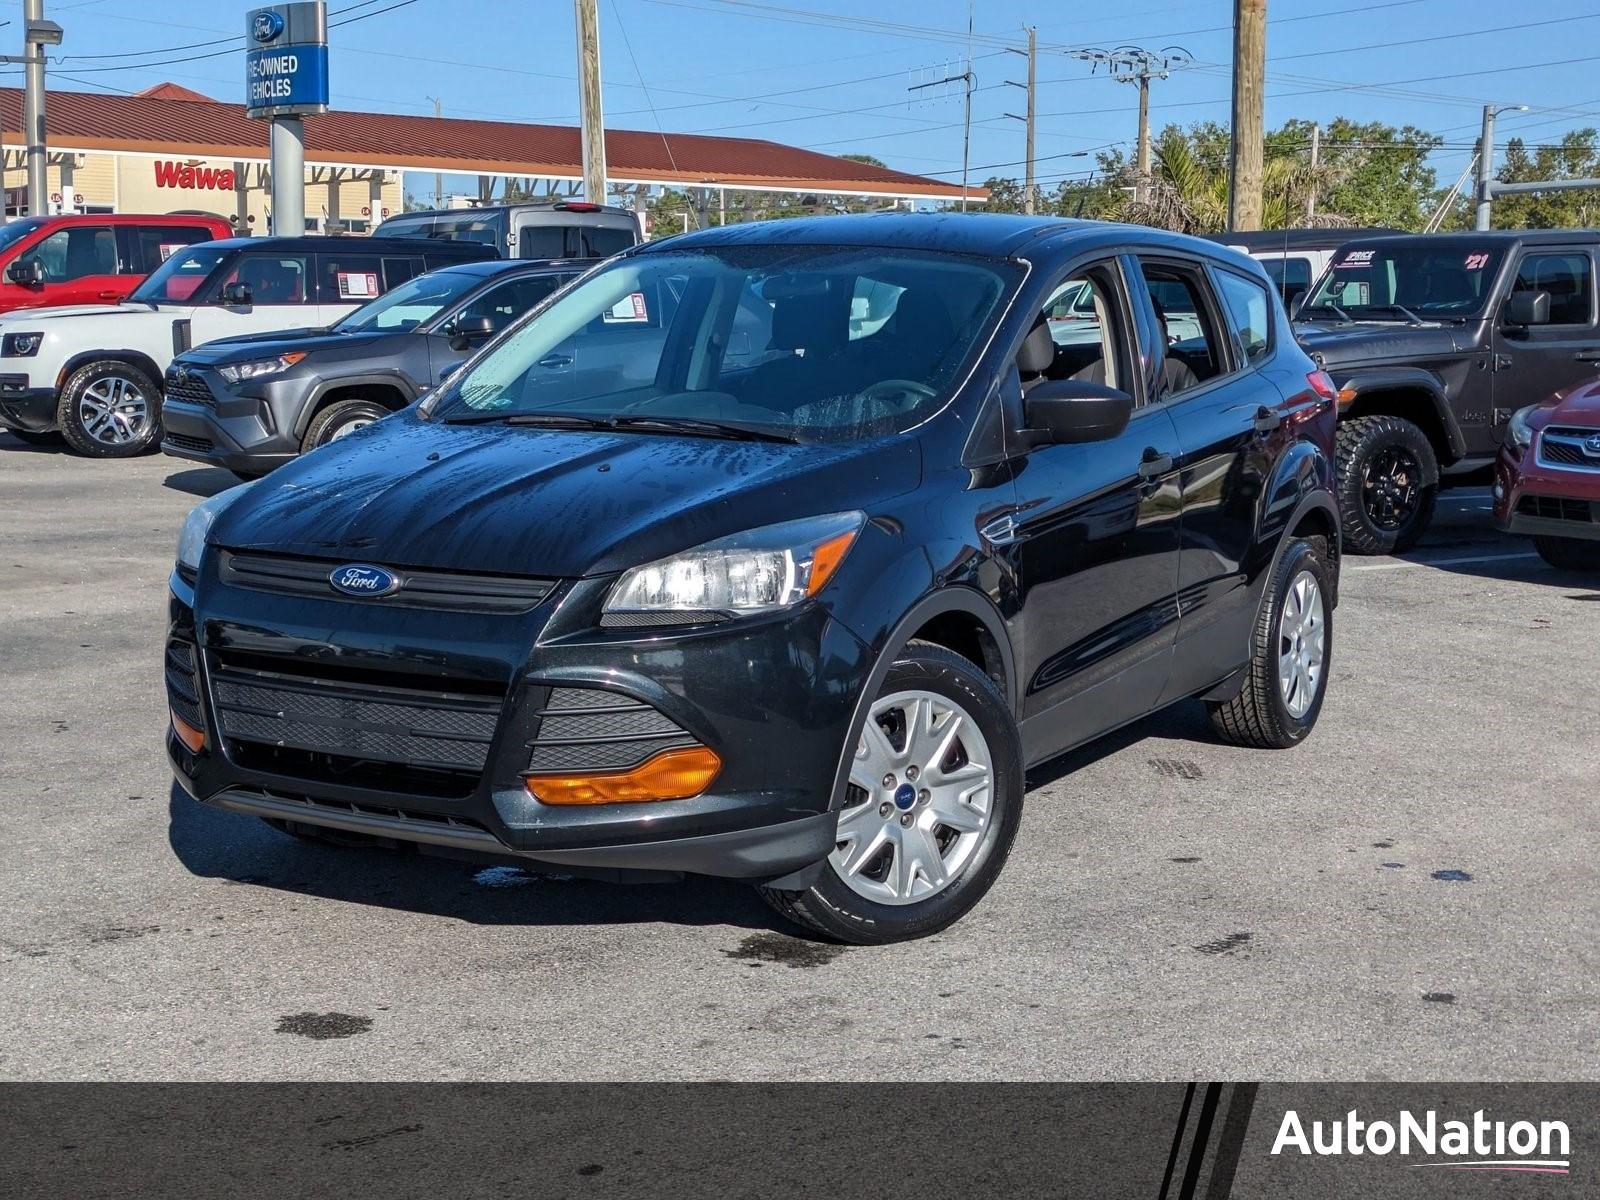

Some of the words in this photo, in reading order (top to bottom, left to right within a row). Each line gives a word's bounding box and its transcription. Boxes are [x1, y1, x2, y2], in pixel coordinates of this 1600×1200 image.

[255, 17, 271, 36] Ford
[154, 160, 235, 190] Wawa
[342, 568, 379, 589] Ford
